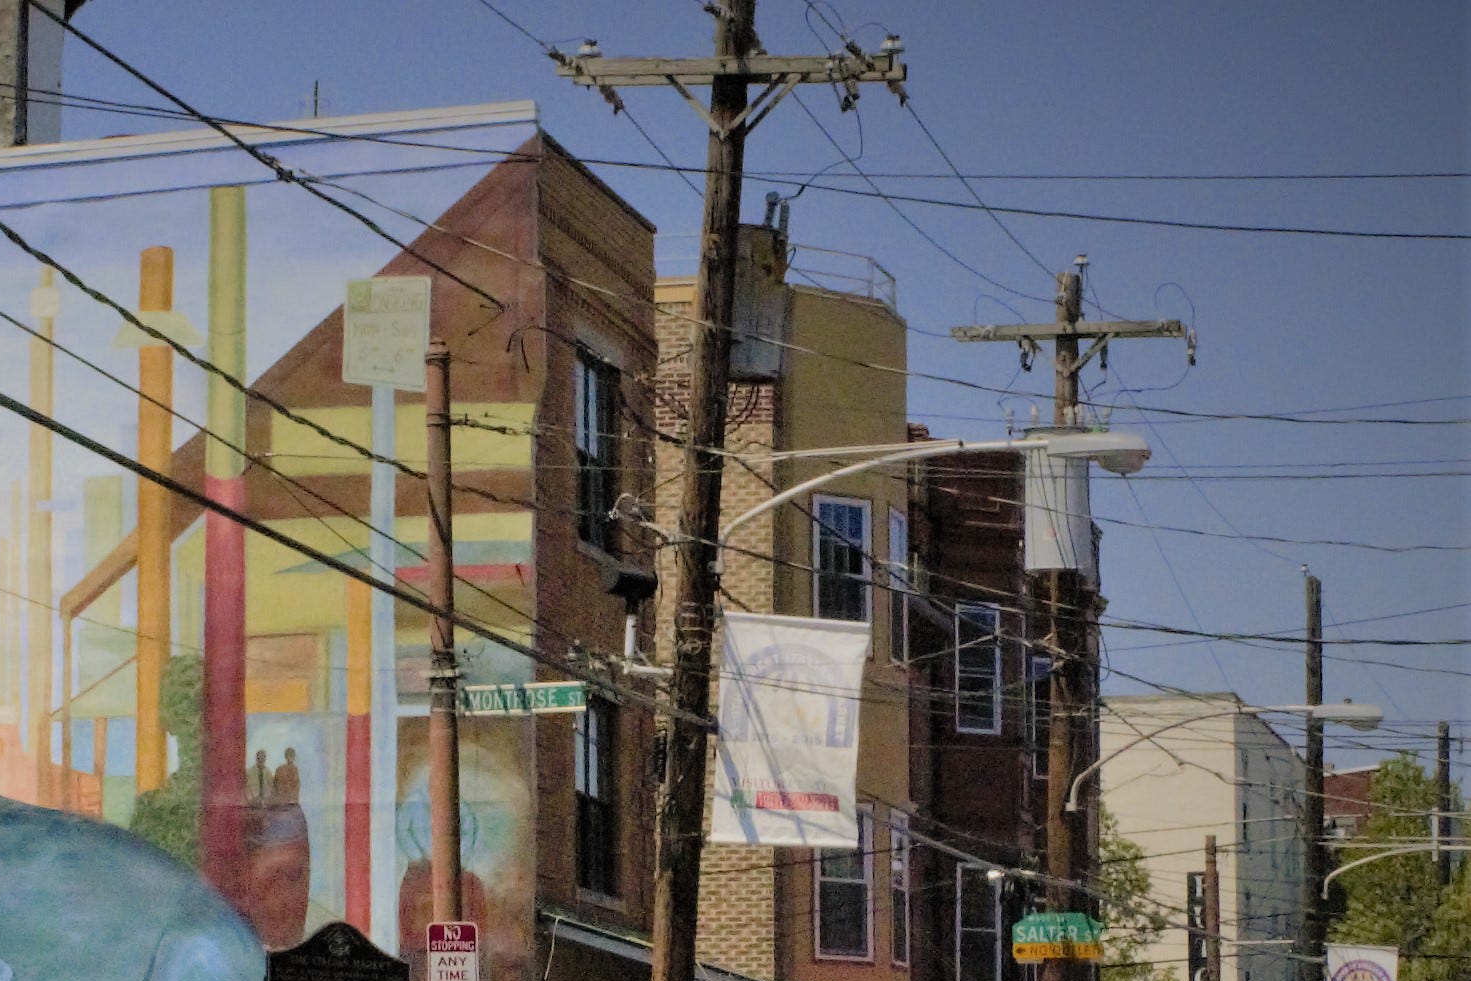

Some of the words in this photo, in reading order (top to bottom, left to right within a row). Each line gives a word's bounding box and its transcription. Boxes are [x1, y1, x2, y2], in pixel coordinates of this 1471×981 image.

[567, 691, 582, 706] ST
[443, 925, 462, 940] NO
[1016, 925, 1078, 943] SALTER
[431, 940, 475, 952] STOPPING
[438, 956, 467, 967] ANY
[437, 970, 469, 981] TIME
